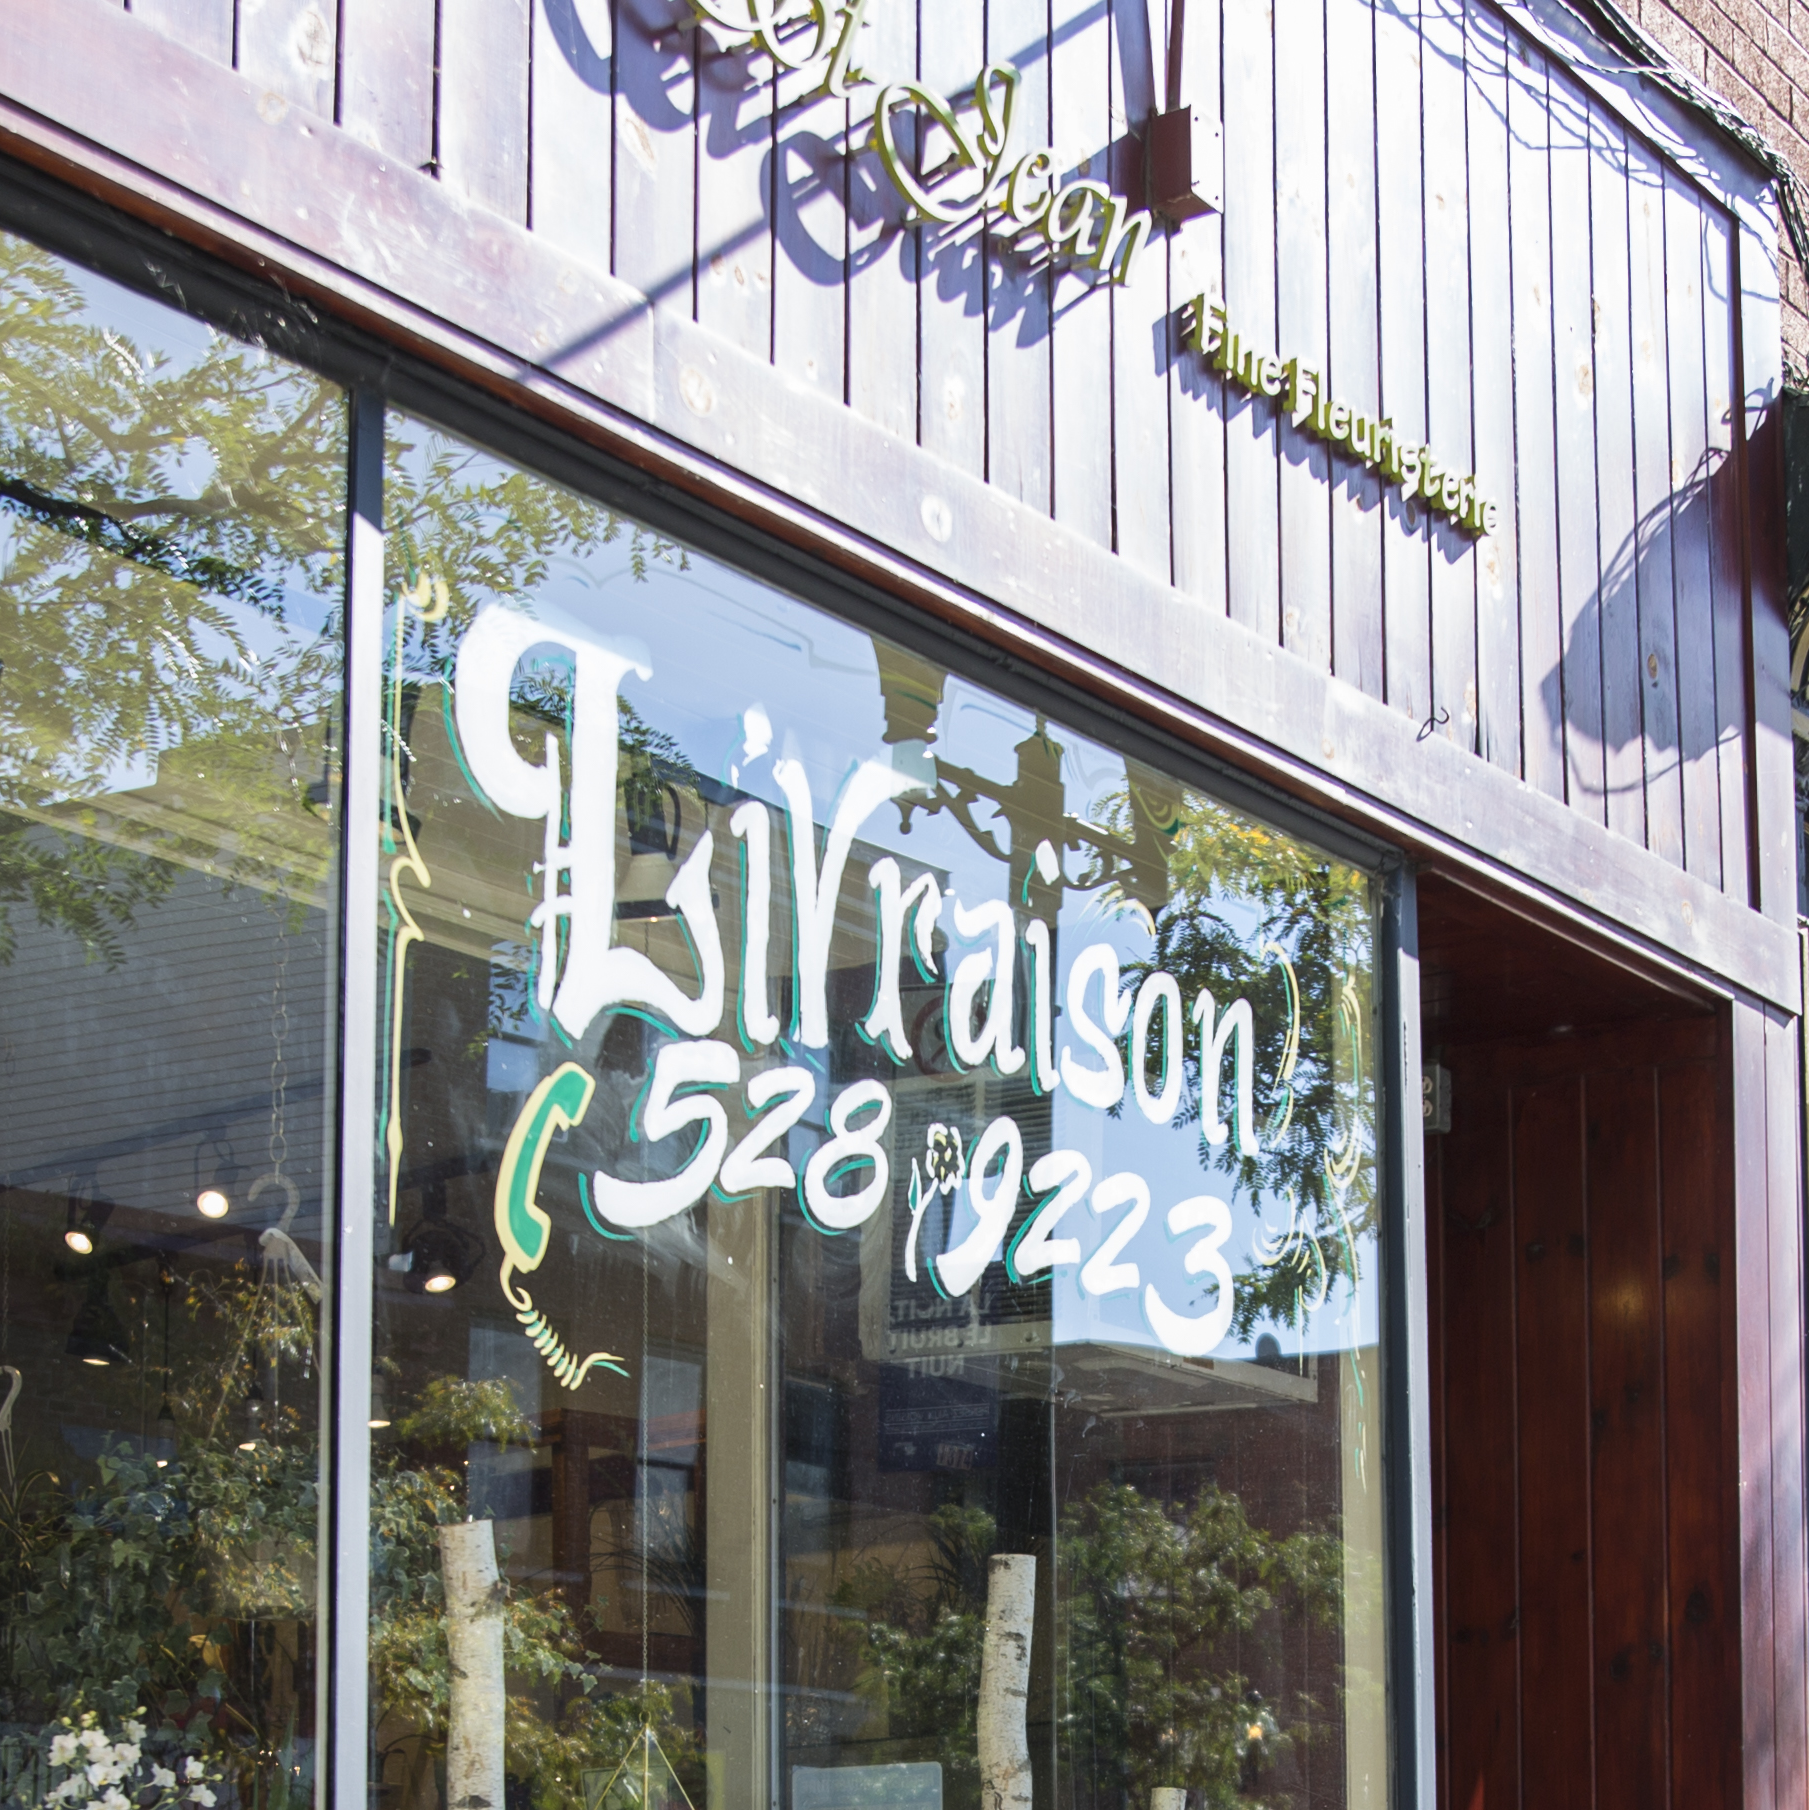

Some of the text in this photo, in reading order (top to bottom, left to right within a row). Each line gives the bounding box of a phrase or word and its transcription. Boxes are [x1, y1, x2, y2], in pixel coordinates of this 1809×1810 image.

[1288, 353, 1499, 537] Fleuristerie
[592, 1040, 1233, 1357] 528 9223
